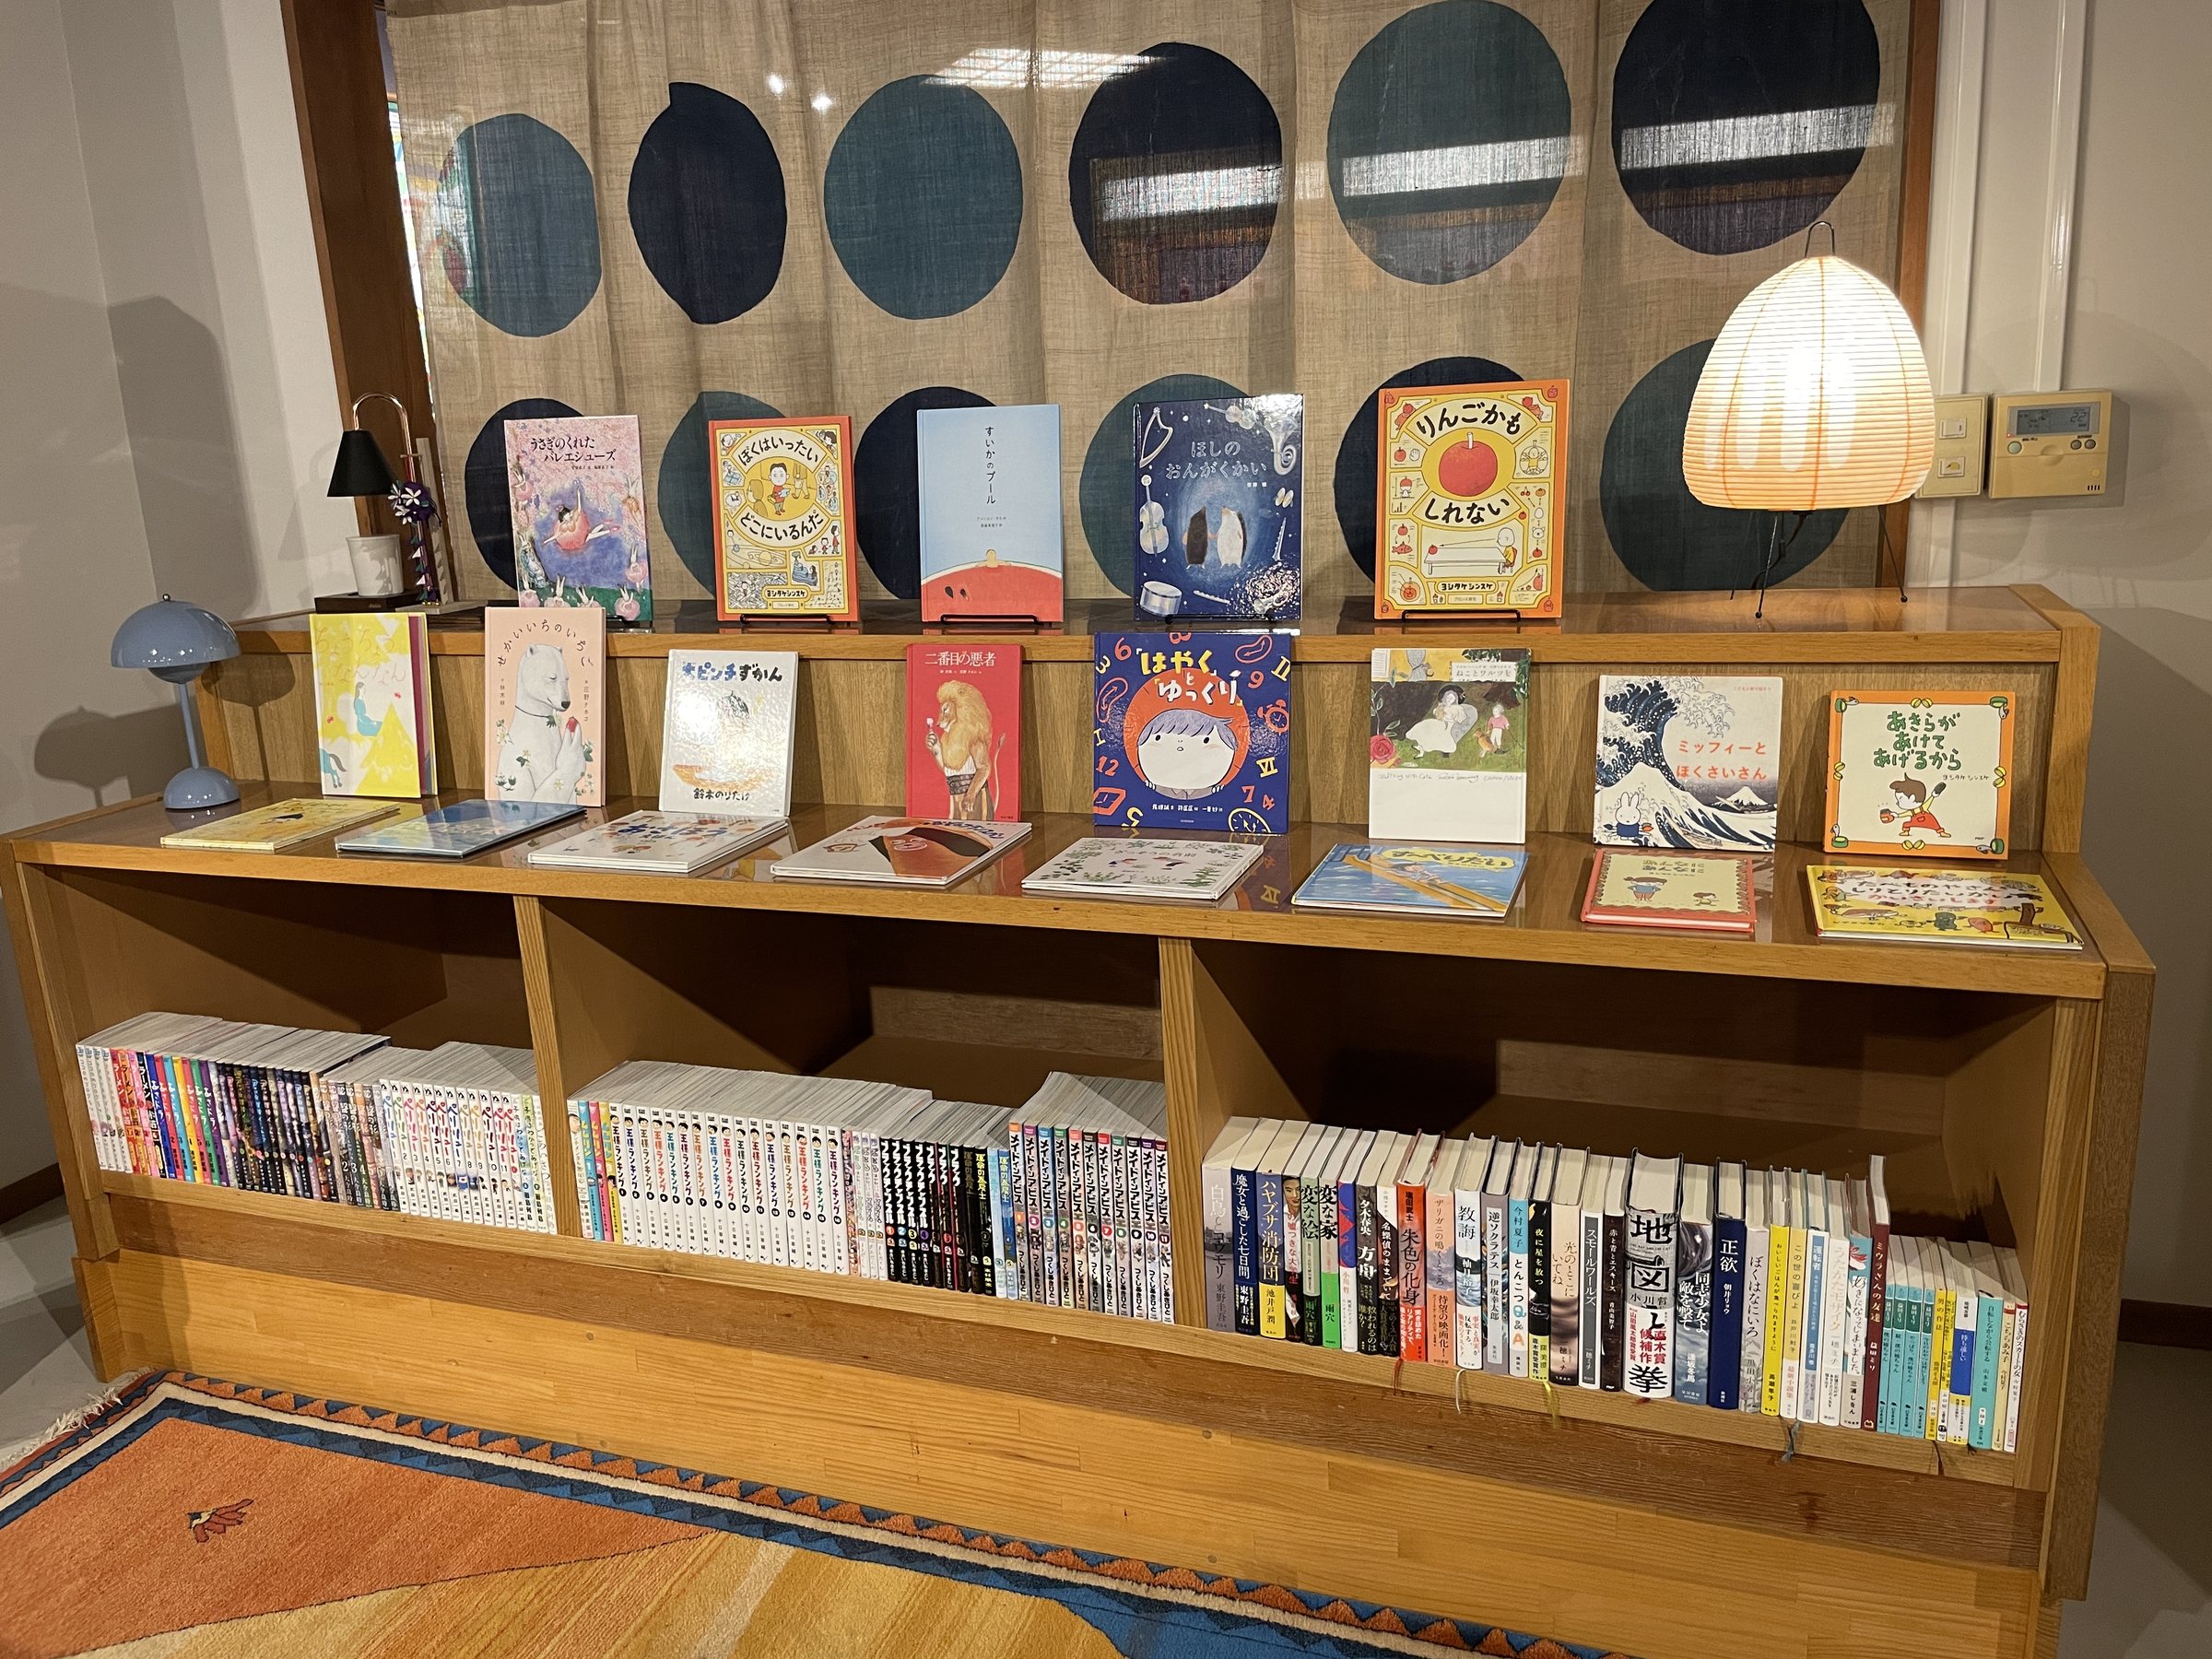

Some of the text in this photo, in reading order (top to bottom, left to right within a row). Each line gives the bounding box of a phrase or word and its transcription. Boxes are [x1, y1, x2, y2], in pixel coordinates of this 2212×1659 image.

[1416, 402, 1522, 438] りんごかも
[530, 436, 595, 451] うさぎのくれた
[544, 449, 617, 462] バレエシューズ
[737, 436, 819, 466] ぼくはいったい
[984, 426, 996, 505] すいかのプール
[1191, 441, 1241, 457] ほしの
[1165, 461, 1267, 479] おんがくかい
[740, 509, 825, 541] どこにいるんだ
[1424, 498, 1510, 524] しれない
[766, 589, 806, 598] ヨシタケシンスケ
[1441, 582, 1494, 592] ヨシタケシンスケ
[498, 618, 594, 667] せかいいちのいちご
[924, 651, 996, 667] 二番目の悪者
[1114, 637, 1132, 661] 6
[682, 662, 782, 682] 大ピンチずかん
[1186, 671, 1195, 686] と
[1247, 670, 1265, 689] 9
[1456, 669, 1512, 677] ねことワルツを
[1887, 711, 1961, 733] あきらが
[1892, 731, 1945, 752] あけて
[1096, 756, 1119, 777] 12
[1678, 740, 1767, 755] ミッフィーと
[1873, 747, 1962, 771] あげるから
[693, 787, 750, 801] 鈴木のりたけ
[1241, 785, 1255, 803] 7
[1676, 765, 1767, 780] ほくさいさん
[1263, 794, 1276, 810] 4
[1641, 865, 1704, 874] あんなに
[1857, 880, 2006, 891] たべものやさん
[341, 1161, 348, 1171] 2
[351, 1162, 358, 1172] 3
[612, 1126, 625, 1187] 王様ランキング
[626, 1129, 638, 1189] 王様ランキング
[640, 1129, 653, 1191] 王様ランキング
[653, 1131, 666, 1192] 王様ランキング
[666, 1133, 678, 1194] 王様ランキング
[680, 1134, 692, 1195] 王様ランキング
[694, 1135, 706, 1196] 王様ランキング
[709, 1136, 722, 1199] 王様ランキング
[723, 1138, 735, 1201] 王様ランキング
[736, 1140, 748, 1204] 王様ランキング
[751, 1141, 763, 1205] 王様ランキング
[767, 1144, 778, 1207] 王様ランキング
[783, 1145, 794, 1208] 王様ランキング
[798, 1147, 810, 1211] 王様ランキング
[1010, 1134, 1022, 1204] メイドインアビス
[1025, 1137, 1038, 1210] メイドインアビス
[1040, 1139, 1053, 1210] メイドインアビス
[1055, 1139, 1067, 1210] メイドインアビス
[1070, 1142, 1083, 1213] メイドインアビス
[813, 1149, 825, 1213] 王様ランキング
[830, 1150, 840, 1215] 王様ランキング
[1085, 1144, 1097, 1215] メイドインアビス
[1100, 1146, 1112, 1218] メイドインアビス
[1113, 1147, 1125, 1219] メイドインアビス
[1128, 1149, 1141, 1221] メイドインアビス
[1143, 1150, 1155, 1223] メイドインアビス
[1157, 1153, 1168, 1225] メイドインアビス
[1232, 1172, 1251, 1280] 魔女と過ごした七日間
[1300, 1185, 1319, 1240] 変な絵
[1319, 1184, 1338, 1240] 変な家
[1359, 1199, 1372, 1236] 夕木春央
[1405, 1191, 1414, 1222] 塩田武士
[1457, 1206, 1476, 1241] 教誨
[1513, 1206, 1524, 1249] 今村夏子
[1211, 1184, 1226, 1280] 白鳥とコウモリ
[1260, 1180, 1279, 1282] ハヤブサ消防団
[1434, 1199, 1445, 1287] ザリガニの鳴くところ
[1488, 1211, 1500, 1270] 逆ソクラテス
[1358, 1245, 1377, 1279] 方舟
[1381, 1221, 1392, 1300] 名探偵のままでいて
[1400, 1228, 1421, 1306] 朱色の化身
[1463, 1259, 1473, 1296] 柚月裕子
[1535, 1229, 1544, 1286] 夜に星を放つ
[1552, 1253, 1564, 1287] いてね
[1564, 1241, 1577, 1298] 光のとこに
[1584, 1229, 1597, 1306] スモールワールズ
[1608, 1229, 1618, 1292] 赤と青とエスキース
[1720, 1239, 1738, 1274] 正欲
[1791, 1244, 1802, 1309] この世の喜びよ
[1811, 1245, 1822, 1271] 運転者
[1216, 1283, 1227, 1324] 東野圭吾
[1489, 1278, 1500, 1321] 伊坂幸太郎
[1694, 1272, 1710, 1336] 同志少女よ、
[1724, 1283, 1732, 1315] 朝井リョウ
[1747, 1255, 1764, 1337] ぼくはなにいろ
[1771, 1243, 1783, 1351] おいしいごはんが食べられますように
[1870, 1241, 1883, 1323] ミウラさんの友達
[1239, 1285, 1250, 1325] 東野圭吾
[1265, 1288, 1276, 1324] 池井戸潤
[1305, 1300, 1315, 1320] 雨穴
[1325, 1303, 1335, 1323] 雨穴
[1677, 1280, 1694, 1331] 敵を撃て
[1367, 1304, 1377, 1352] 救われるのは
[1640, 1328, 1652, 1364] 候補作
[1654, 1328, 1666, 1365] 直木賞
[1984, 1305, 1994, 1362] 自転しながら公転する
[2002, 1323, 2011, 1363] こちらあみ子
[2013, 1311, 2027, 1378] むらさきのスカートの女
[1686, 1352, 1696, 1383] 逢坂冬馬
[1869, 1342, 1878, 1371] 益田ミリ
[1849, 1380, 1858, 1415] 三浦しをん
